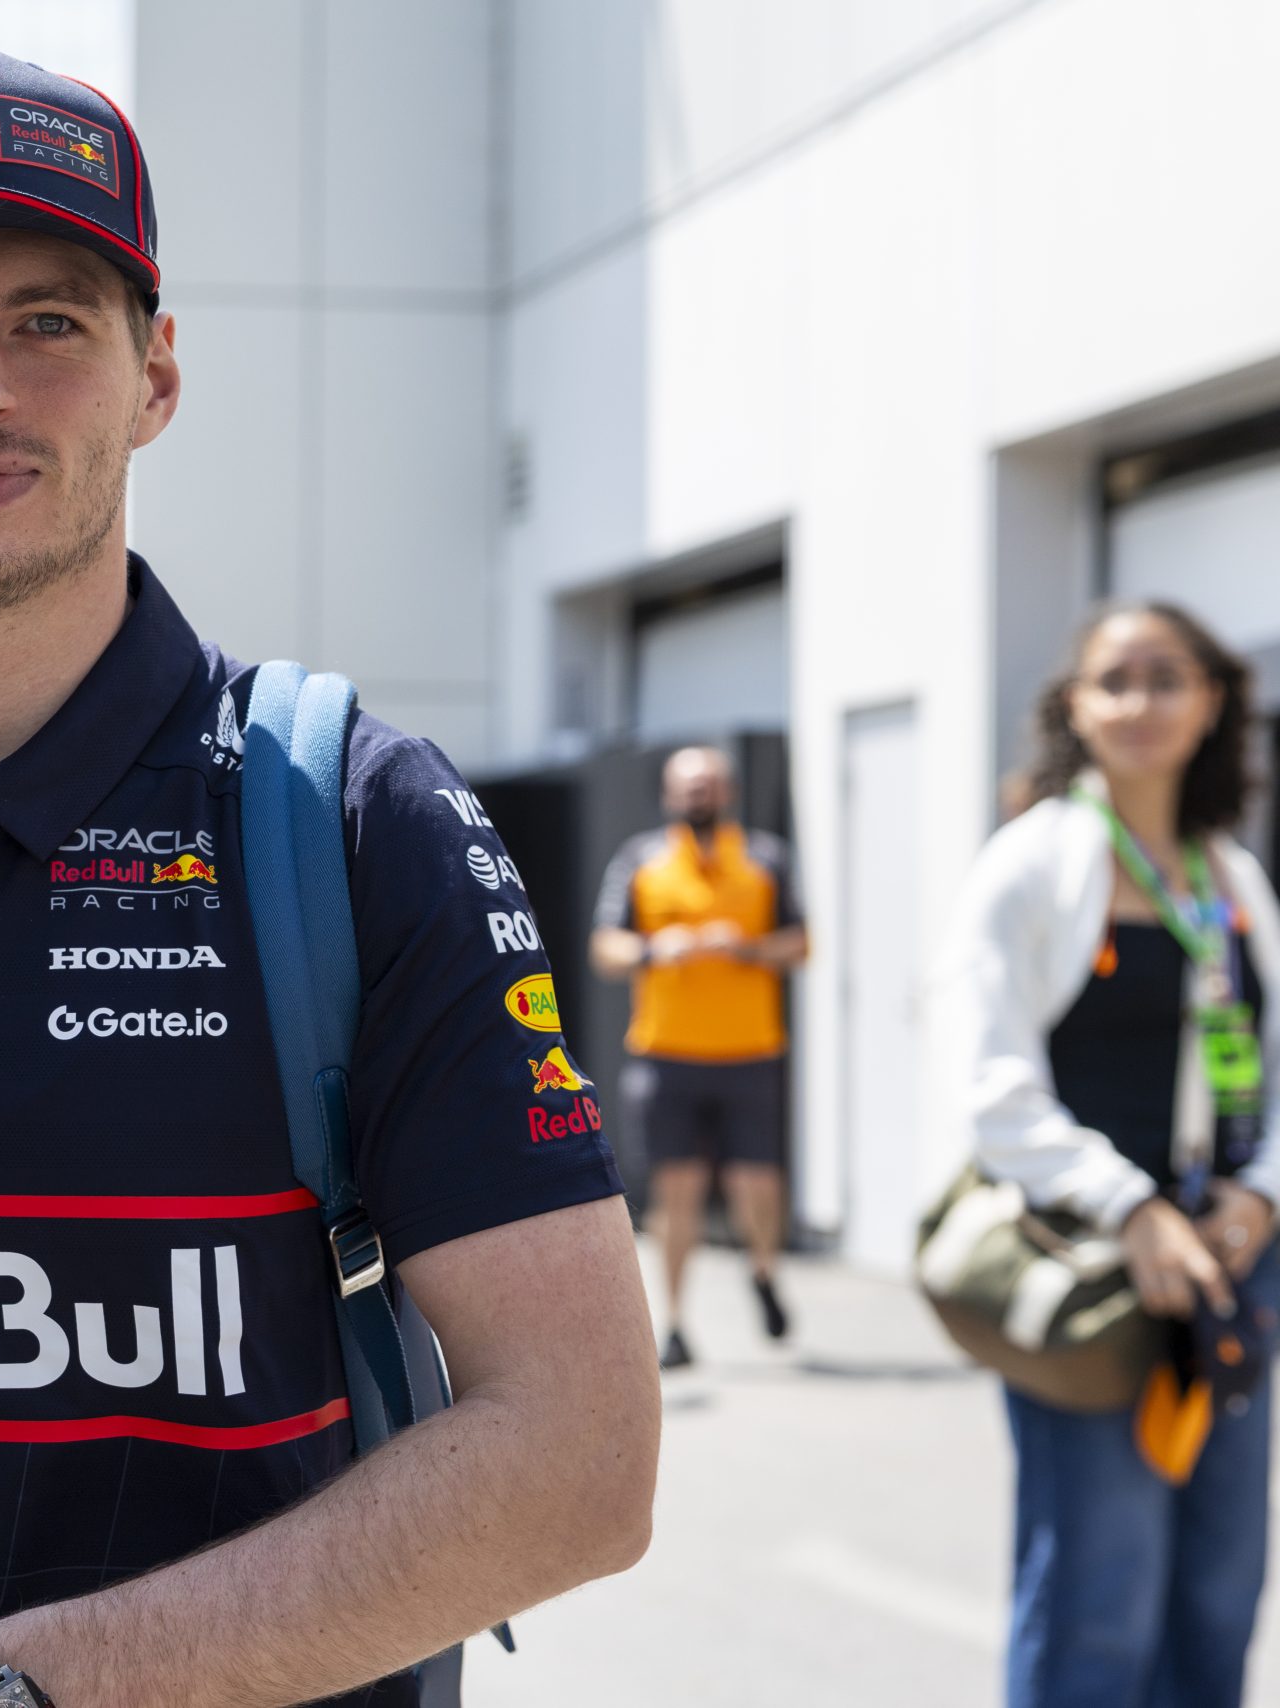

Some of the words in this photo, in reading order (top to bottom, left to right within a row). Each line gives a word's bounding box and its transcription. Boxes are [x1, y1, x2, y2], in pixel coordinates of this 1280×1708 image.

[9, 107, 104, 149] ORACLE
[11, 124, 39, 141] Red
[41, 131, 66, 149] Bull
[13, 144, 108, 181] RACING
[200, 732, 244, 771] CST
[433, 788, 494, 828] VIS
[50, 859, 96, 883] Red
[99, 858, 145, 884] Bull
[50, 893, 221, 911] RACING
[486, 910, 545, 953] RO
[48, 945, 226, 970] HONDA
[87, 1007, 228, 1037] Gate.io
[527, 1096, 588, 1143] Red
[582, 1097, 602, 1131] B
